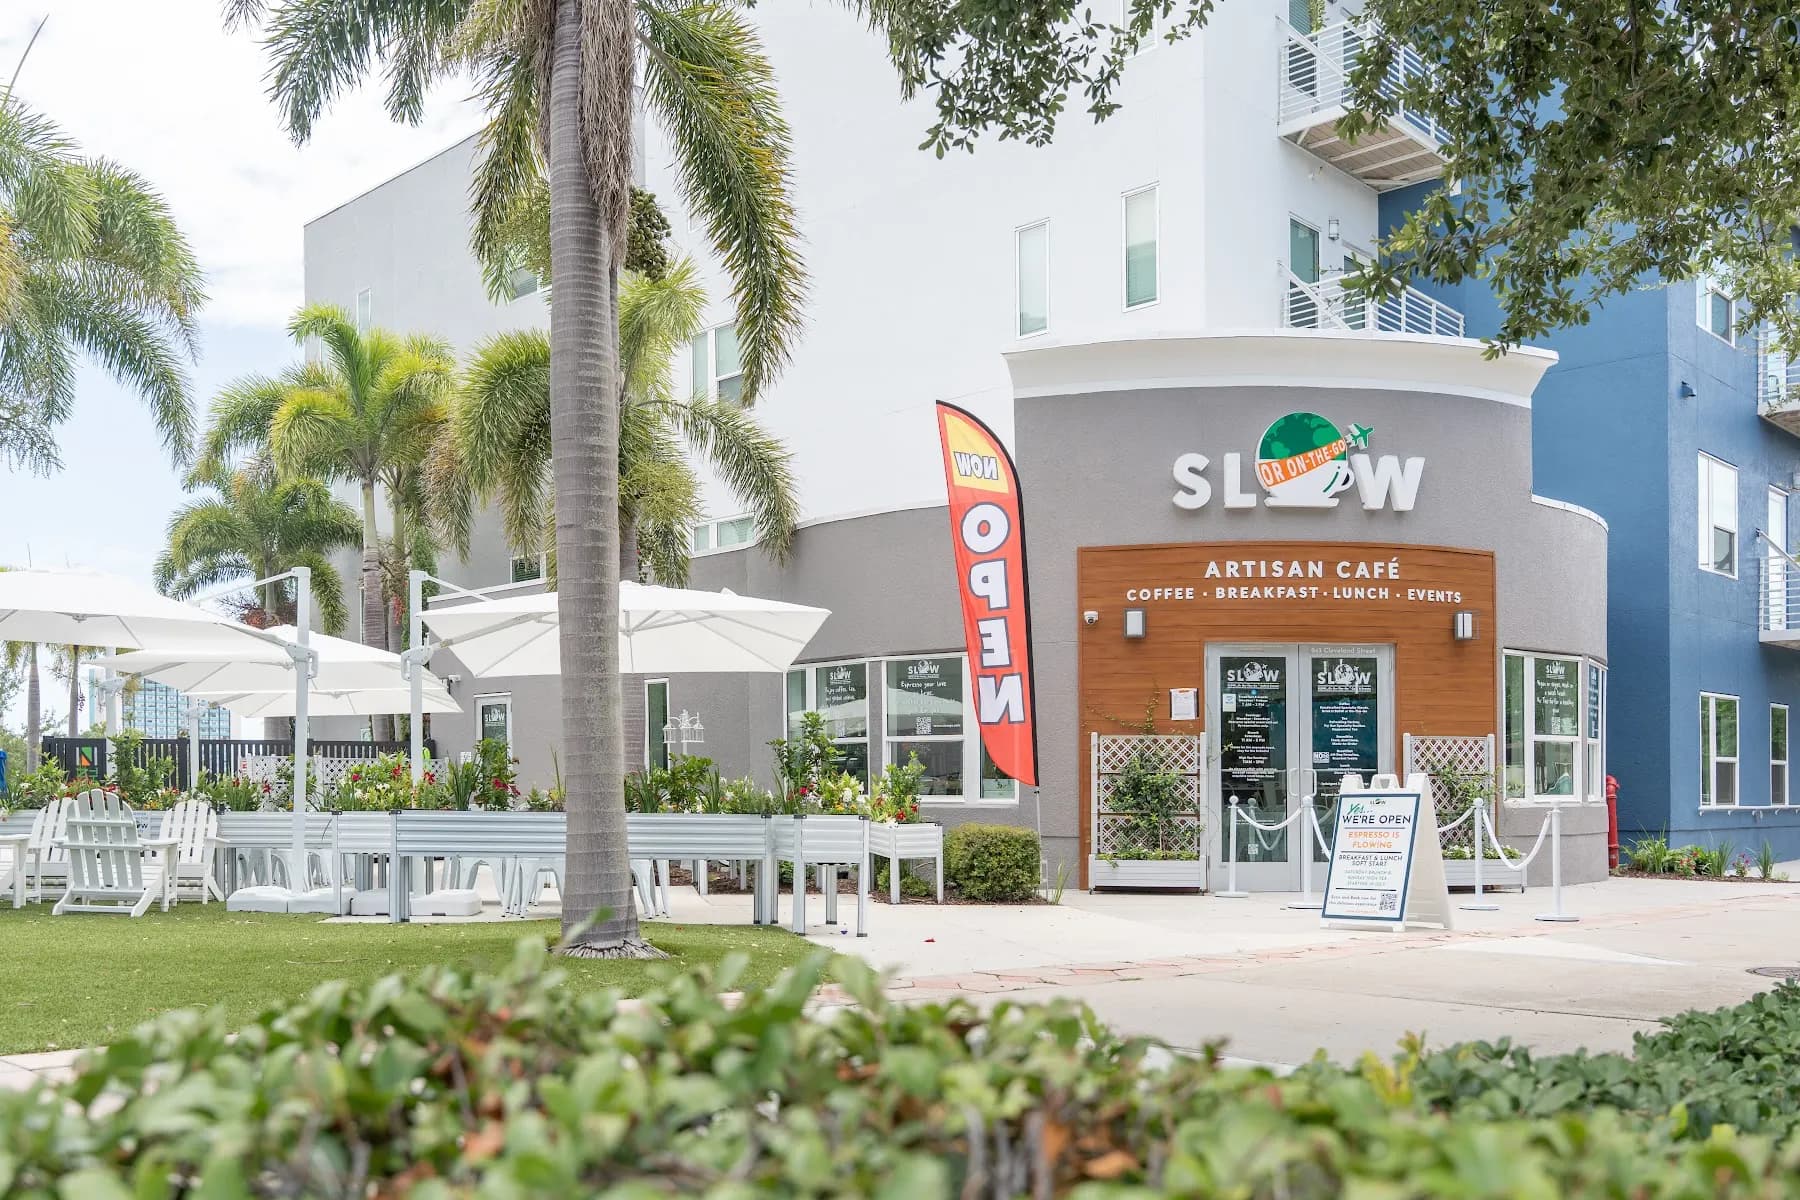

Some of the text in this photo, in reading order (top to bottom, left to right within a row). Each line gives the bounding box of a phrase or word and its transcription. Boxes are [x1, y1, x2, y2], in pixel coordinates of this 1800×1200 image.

[1261, 438, 1346, 487] OR ON-THE-GO
[1204, 556, 1401, 580] ARTISAN CAFÉ
[1126, 586, 1462, 604] COFFEE BREAKFAST LUNCH EVENTS
[1227, 661, 1280, 682] SLOW
[1342, 815, 1412, 825] WE'RE OPEN
[1348, 831, 1400, 839] ESPRESSO IS
[1352, 841, 1393, 849] FLOWING
